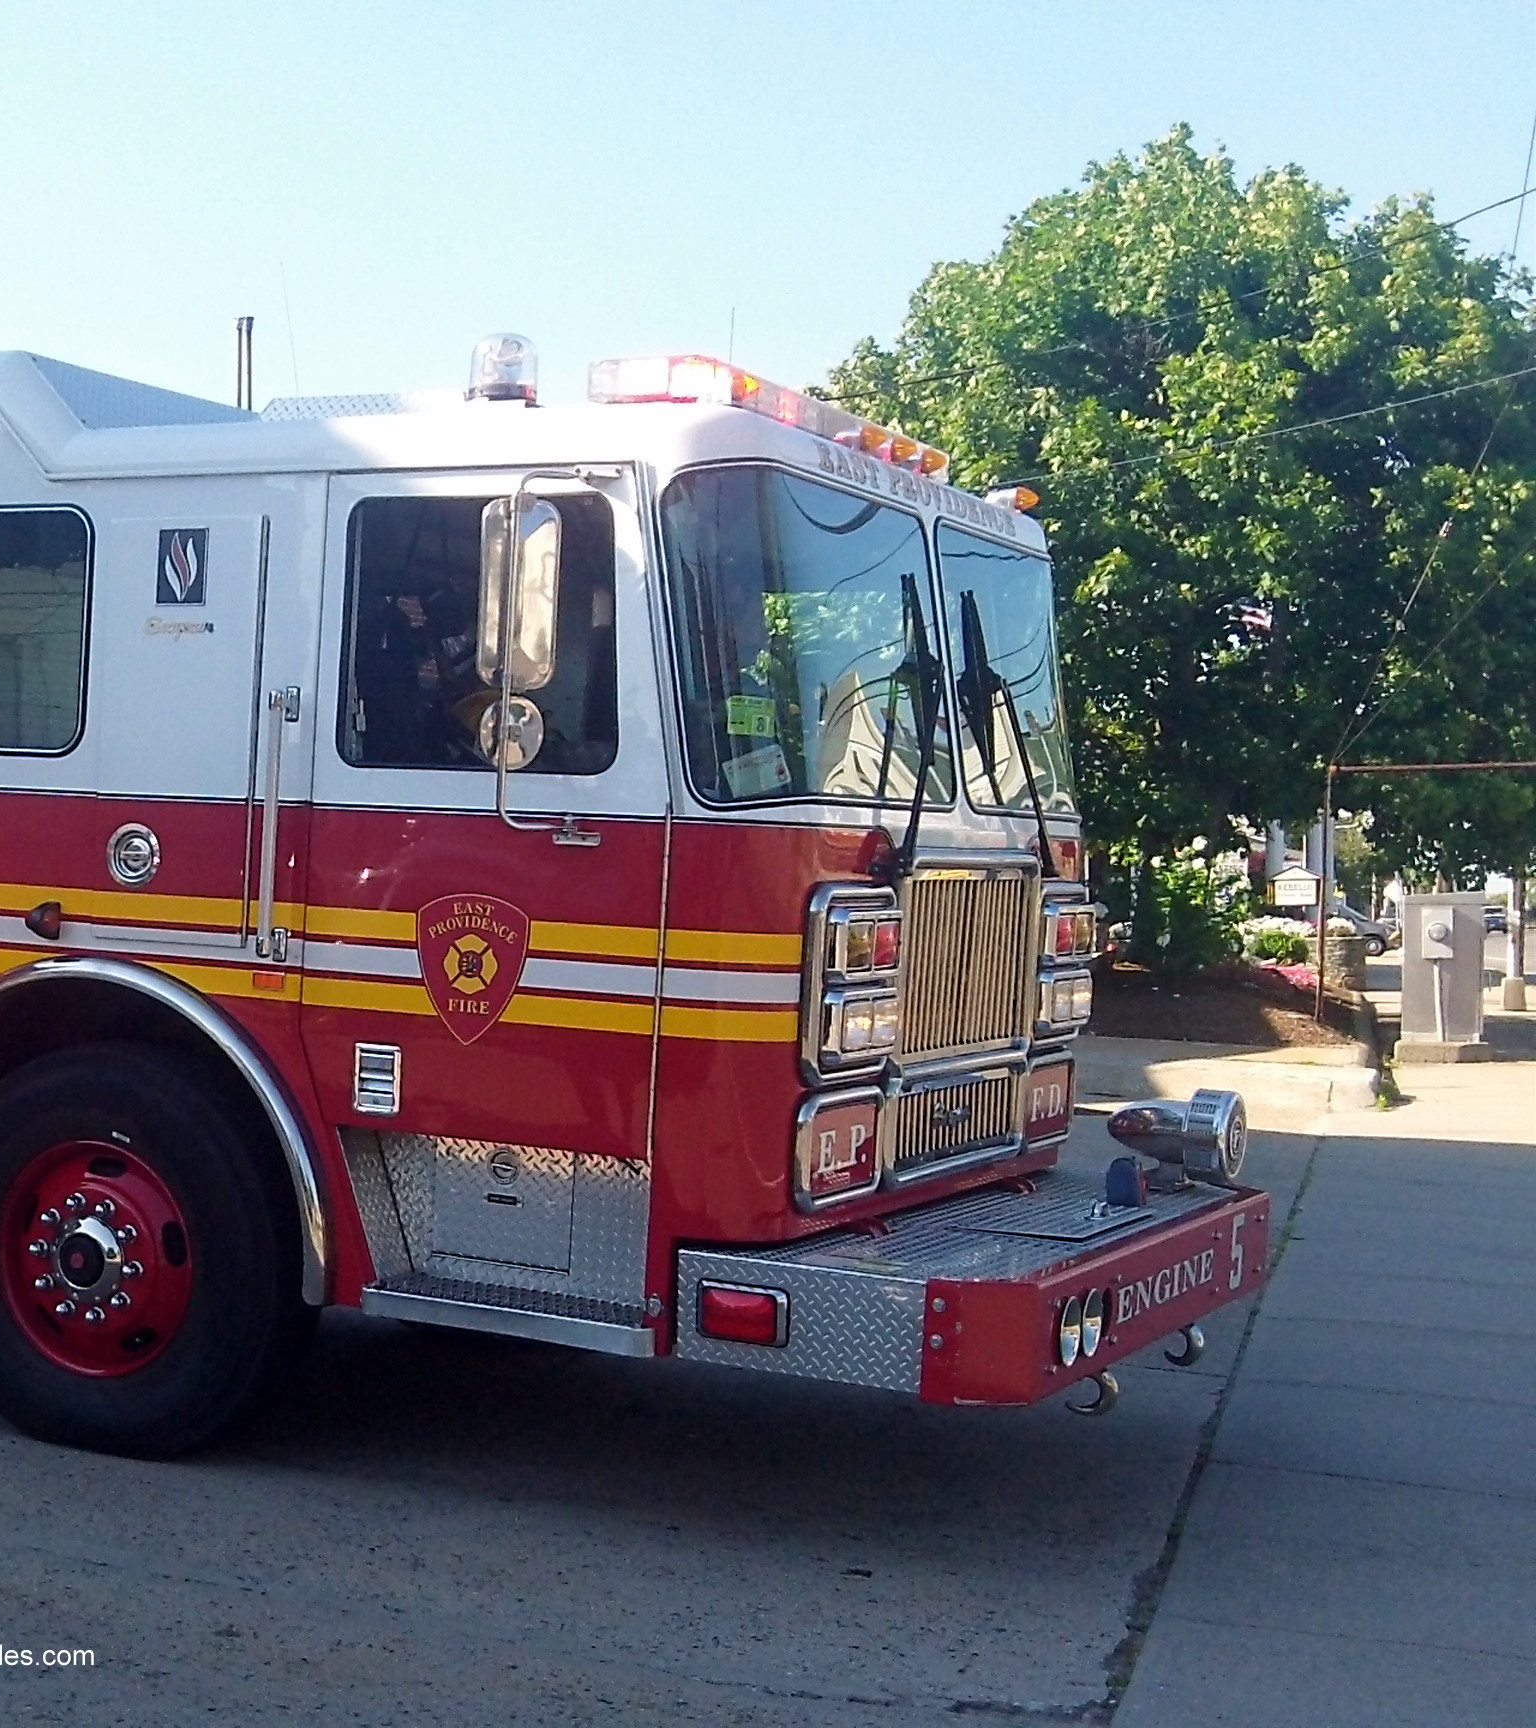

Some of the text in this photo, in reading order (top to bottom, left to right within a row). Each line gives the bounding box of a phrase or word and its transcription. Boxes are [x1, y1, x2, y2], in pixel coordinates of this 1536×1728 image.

[453, 902, 495, 916] EAST
[428, 914, 519, 944] PROVIDENCE
[448, 998, 490, 1015] FIRE
[1030, 1082, 1064, 1123] F.D.
[817, 1123, 867, 1173] E.P.
[1116, 1213, 1246, 1324] ENGINE 5
